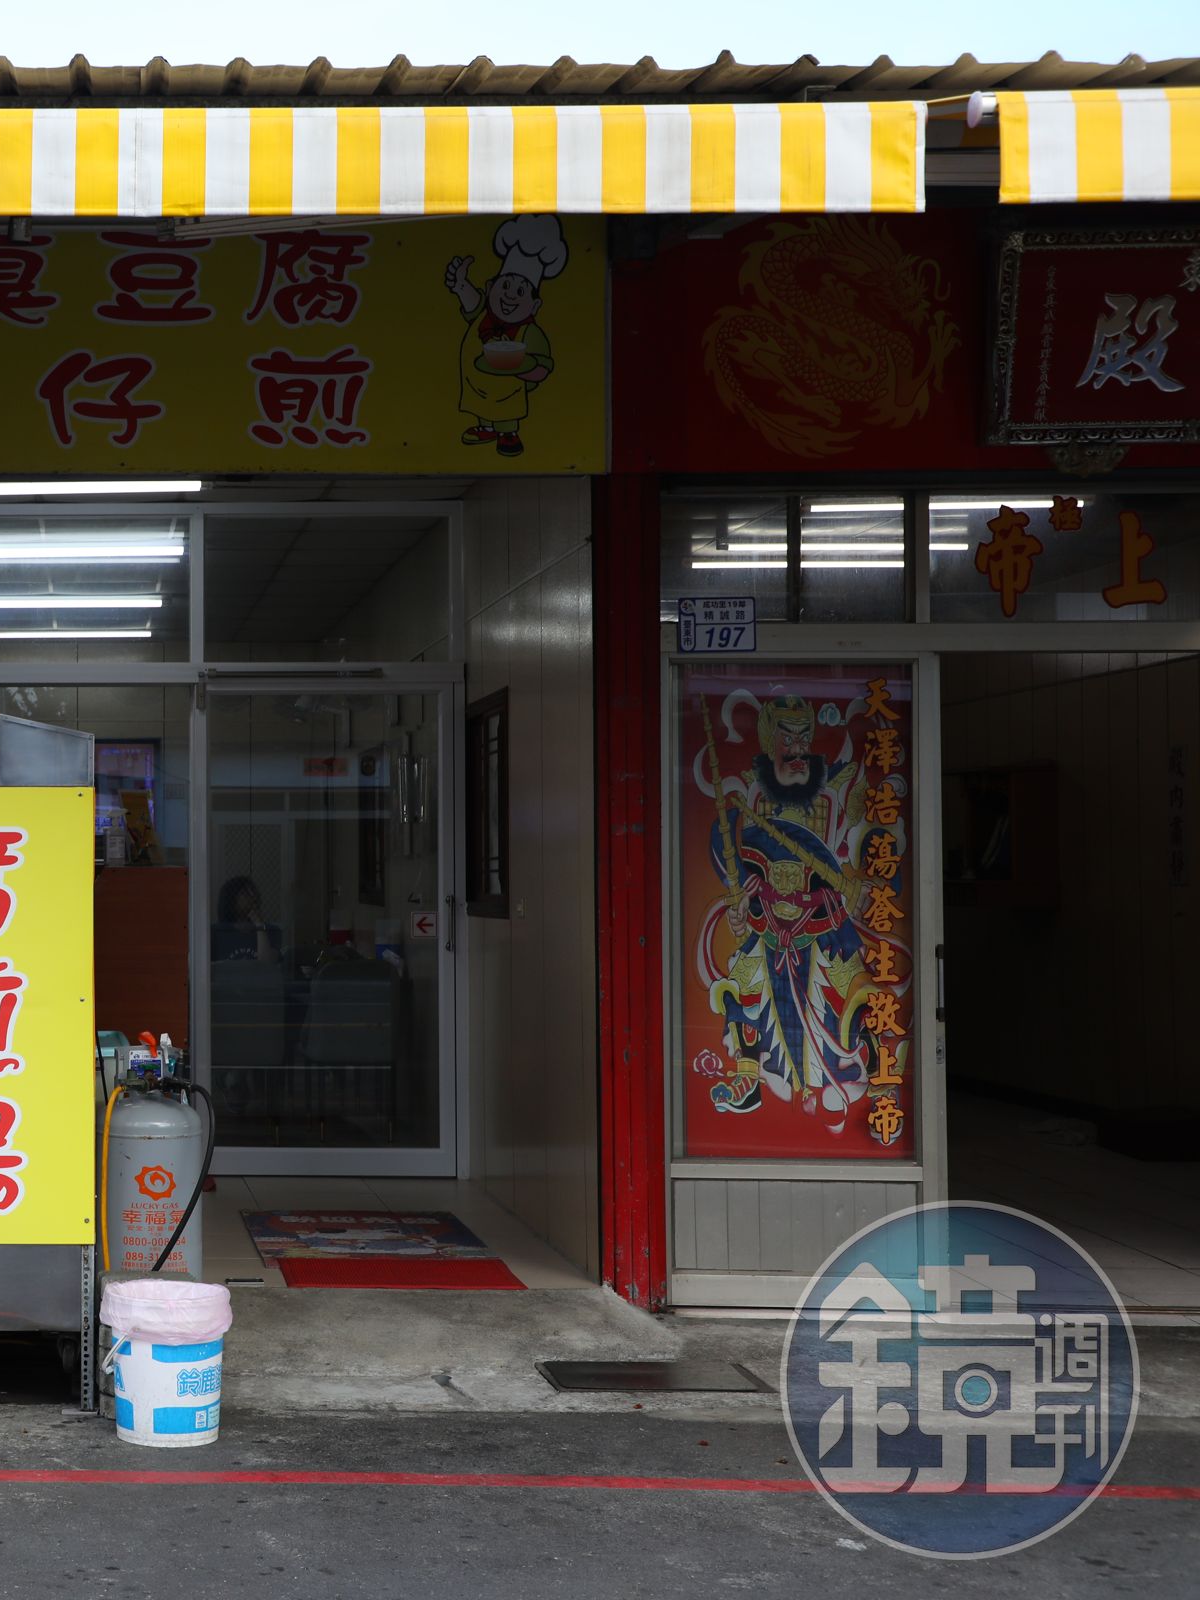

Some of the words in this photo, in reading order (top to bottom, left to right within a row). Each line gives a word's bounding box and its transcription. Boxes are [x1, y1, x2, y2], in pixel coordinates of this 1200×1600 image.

[1075, 292, 1186, 393] 殿
[1048, 495, 1083, 531] 極
[704, 611, 745, 621] 精誠路
[705, 627, 746, 648] 197
